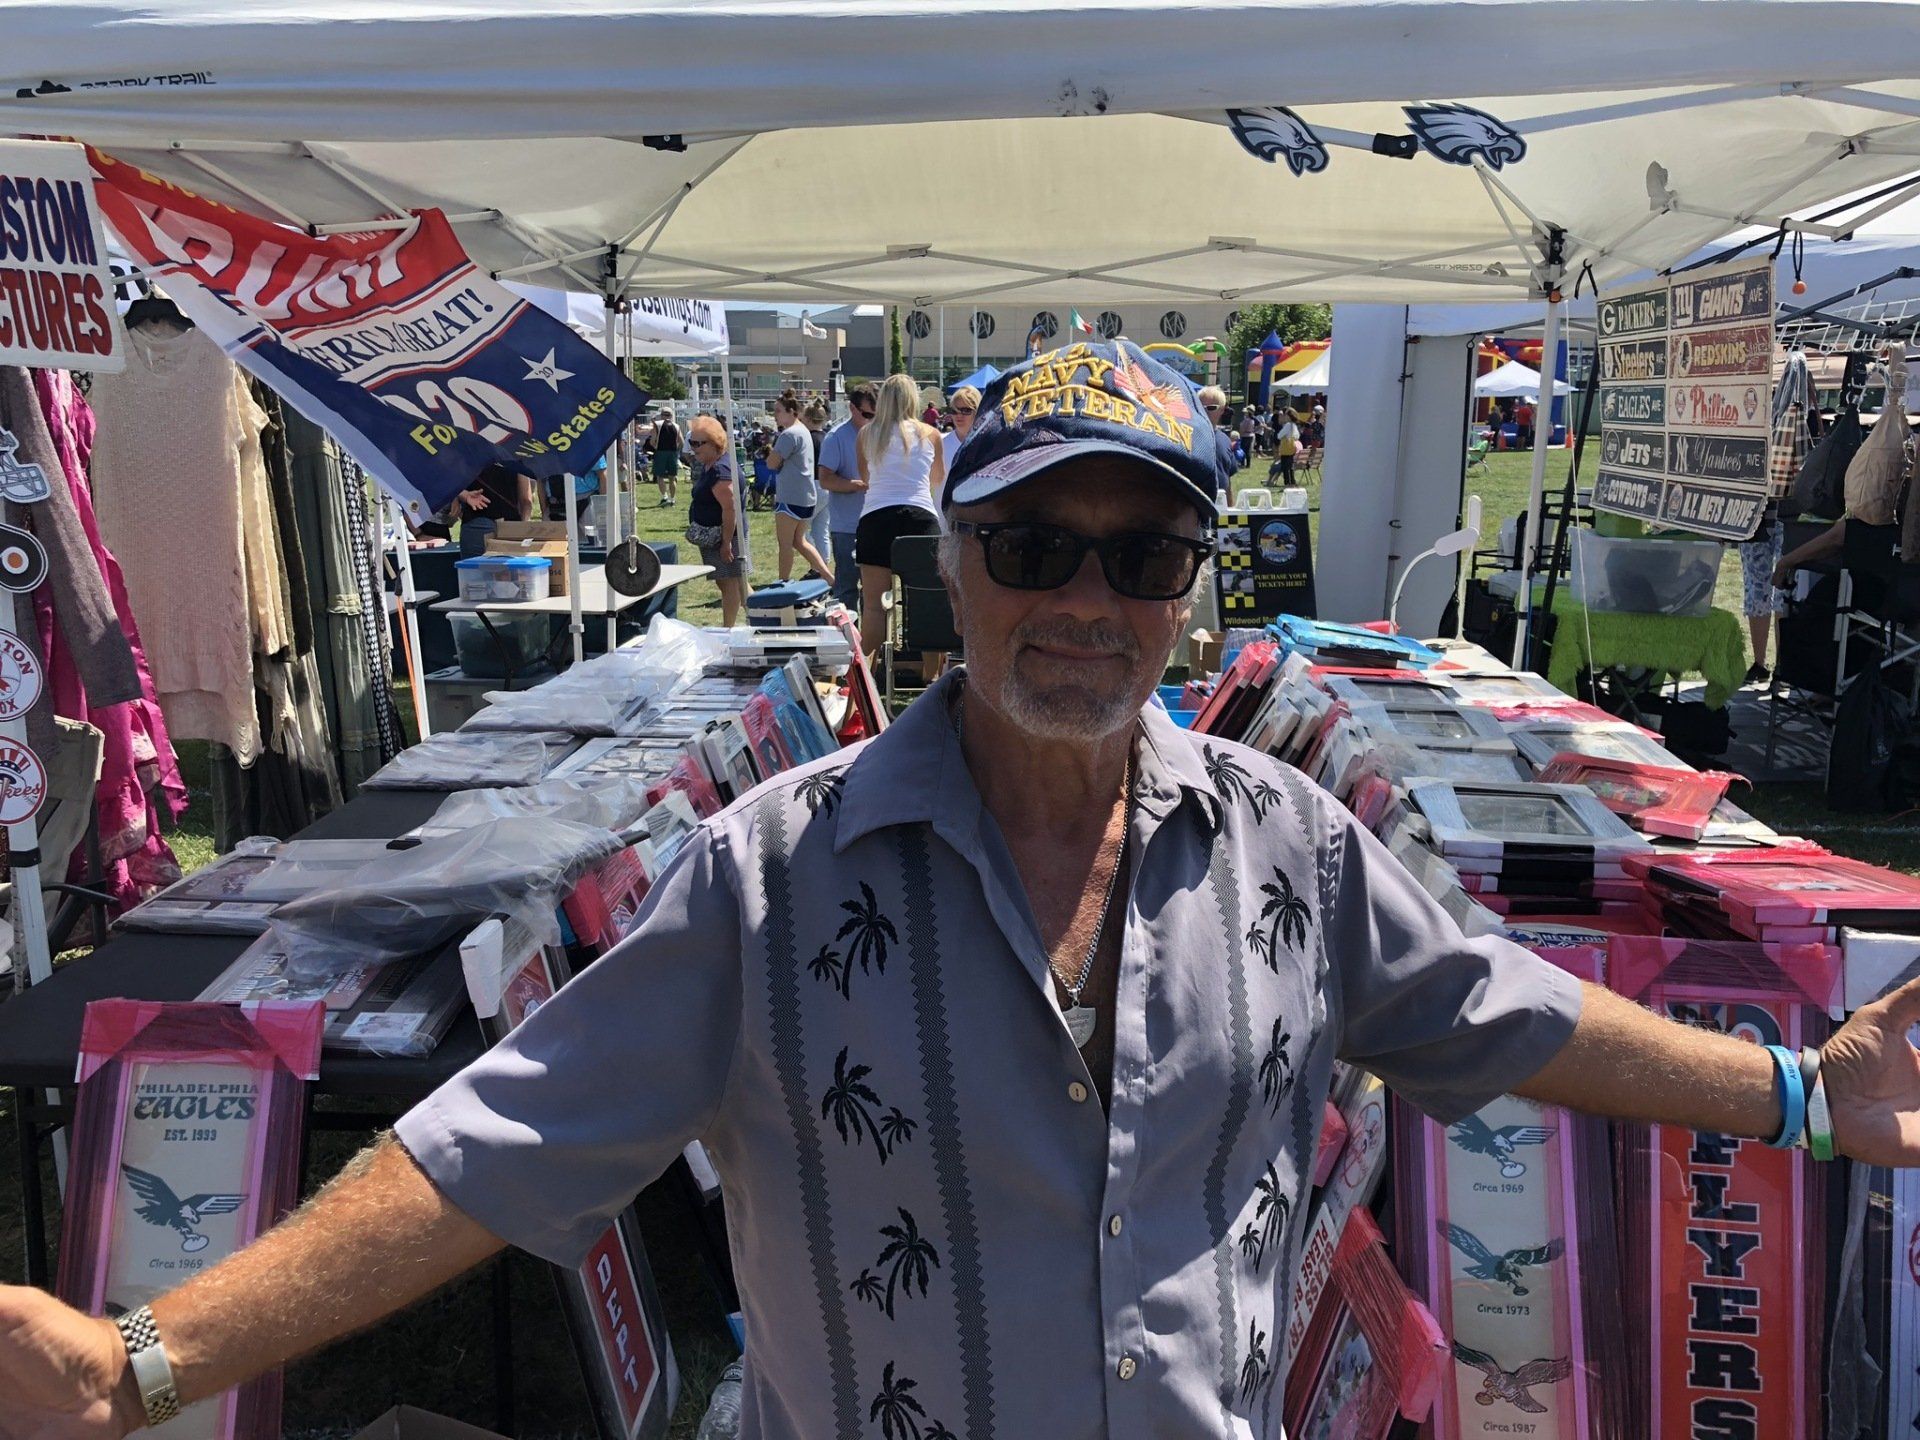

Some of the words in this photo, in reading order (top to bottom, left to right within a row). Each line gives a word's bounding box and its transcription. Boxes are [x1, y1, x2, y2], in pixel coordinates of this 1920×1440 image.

[1699, 281, 1746, 320] GIANTS
[1618, 300, 1655, 331] PACKERS
[1615, 344, 1655, 380] Steelers
[1695, 342, 1746, 367] REDSKINS
[1002, 356, 1114, 401] NAVY
[547, 386, 616, 452] States
[1618, 395, 1651, 419] EAGLES
[1690, 385, 1739, 424] Phillies
[1001, 385, 1195, 454] VETERAN
[1620, 437, 1651, 465] JETS
[1694, 437, 1743, 476] Yankees
[1746, 454, 1760, 467] AVE
[1608, 479, 1648, 508] COWBOYS
[1697, 494, 1726, 524] METS
[1721, 499, 1758, 529] DRIVE
[1542, 934, 1572, 944] NEW
[134, 1084, 260, 1095] PHILADELPHIA
[133, 1096, 257, 1121] EAGLES
[163, 1129, 188, 1142] EST.
[1473, 1182, 1498, 1193] Circa
[1501, 1183, 1525, 1194] 1969
[149, 1259, 175, 1269] Circa
[178, 1259, 203, 1269] 1969
[1300, 1219, 1328, 1287] PLEASE
[597, 1253, 640, 1394] DEPT
[1477, 1303, 1503, 1314] Circa
[1506, 1304, 1531, 1315] 1973
[1483, 1421, 1509, 1432] Circa
[1512, 1422, 1537, 1434] 1987
